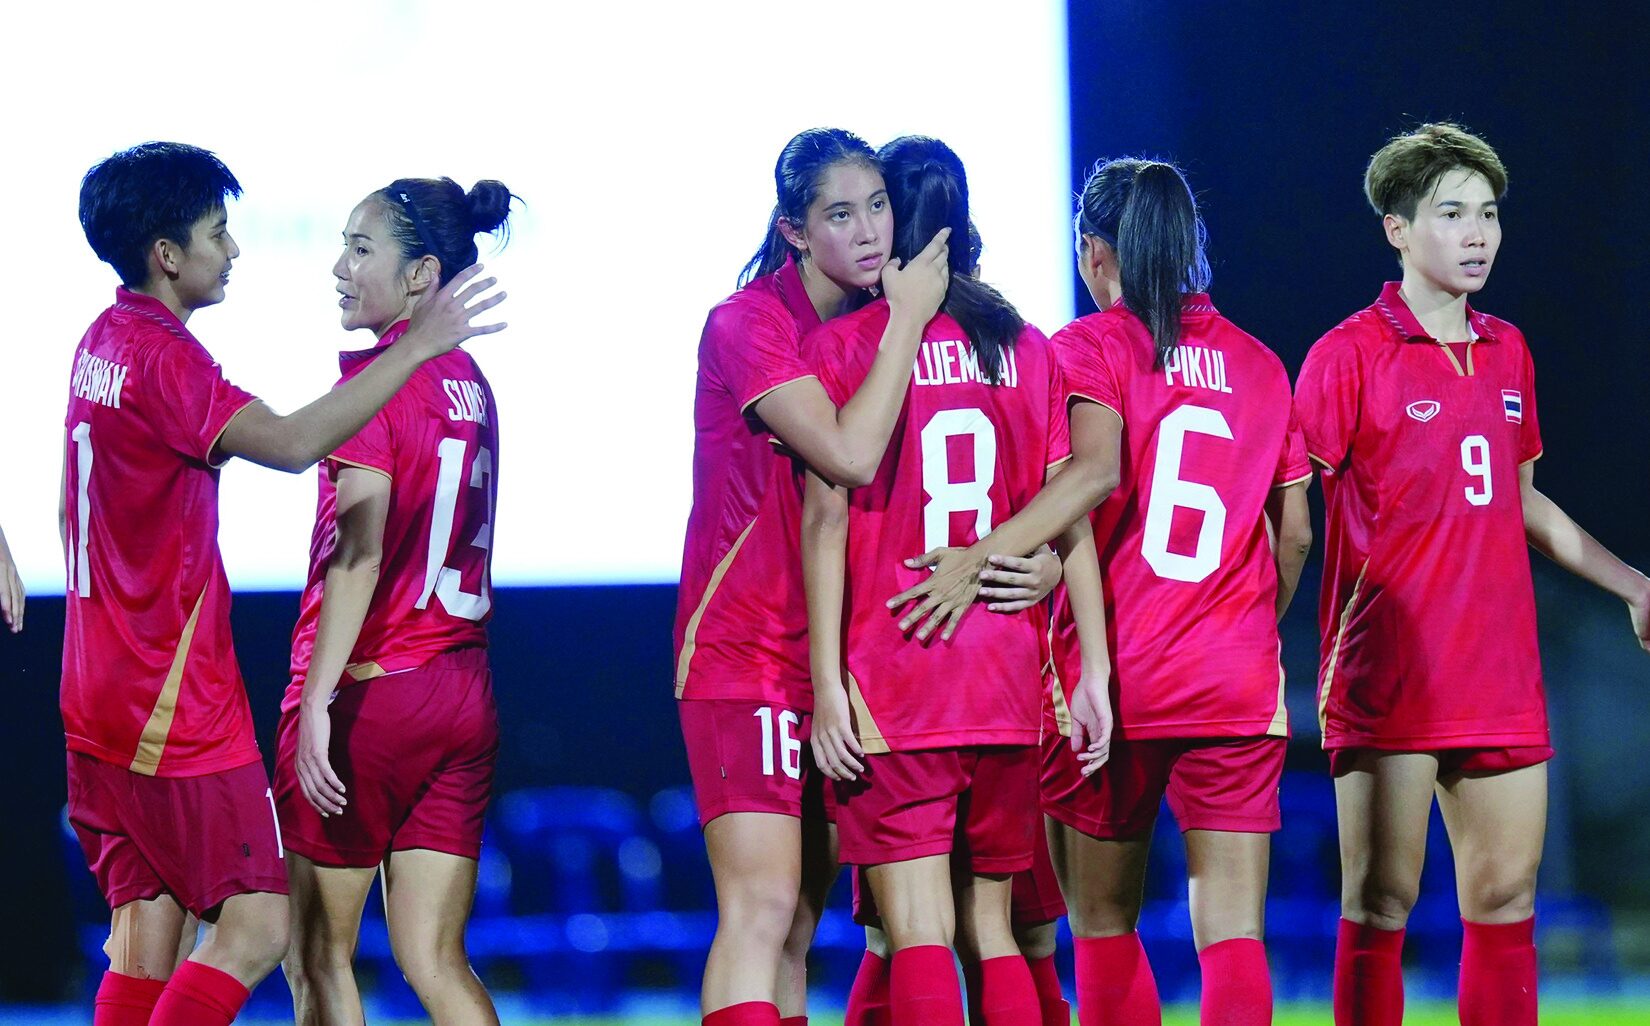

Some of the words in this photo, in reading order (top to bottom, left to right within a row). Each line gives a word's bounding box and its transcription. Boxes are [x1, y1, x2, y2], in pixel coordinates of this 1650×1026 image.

[913, 340, 1018, 388] LUEMAI
[1163, 345, 1233, 394] PIKUL
[920, 408, 997, 554] 8
[1141, 404, 1235, 583] 6
[1460, 434, 1494, 506] 9
[414, 437, 492, 621] 13
[753, 706, 802, 780] 16
